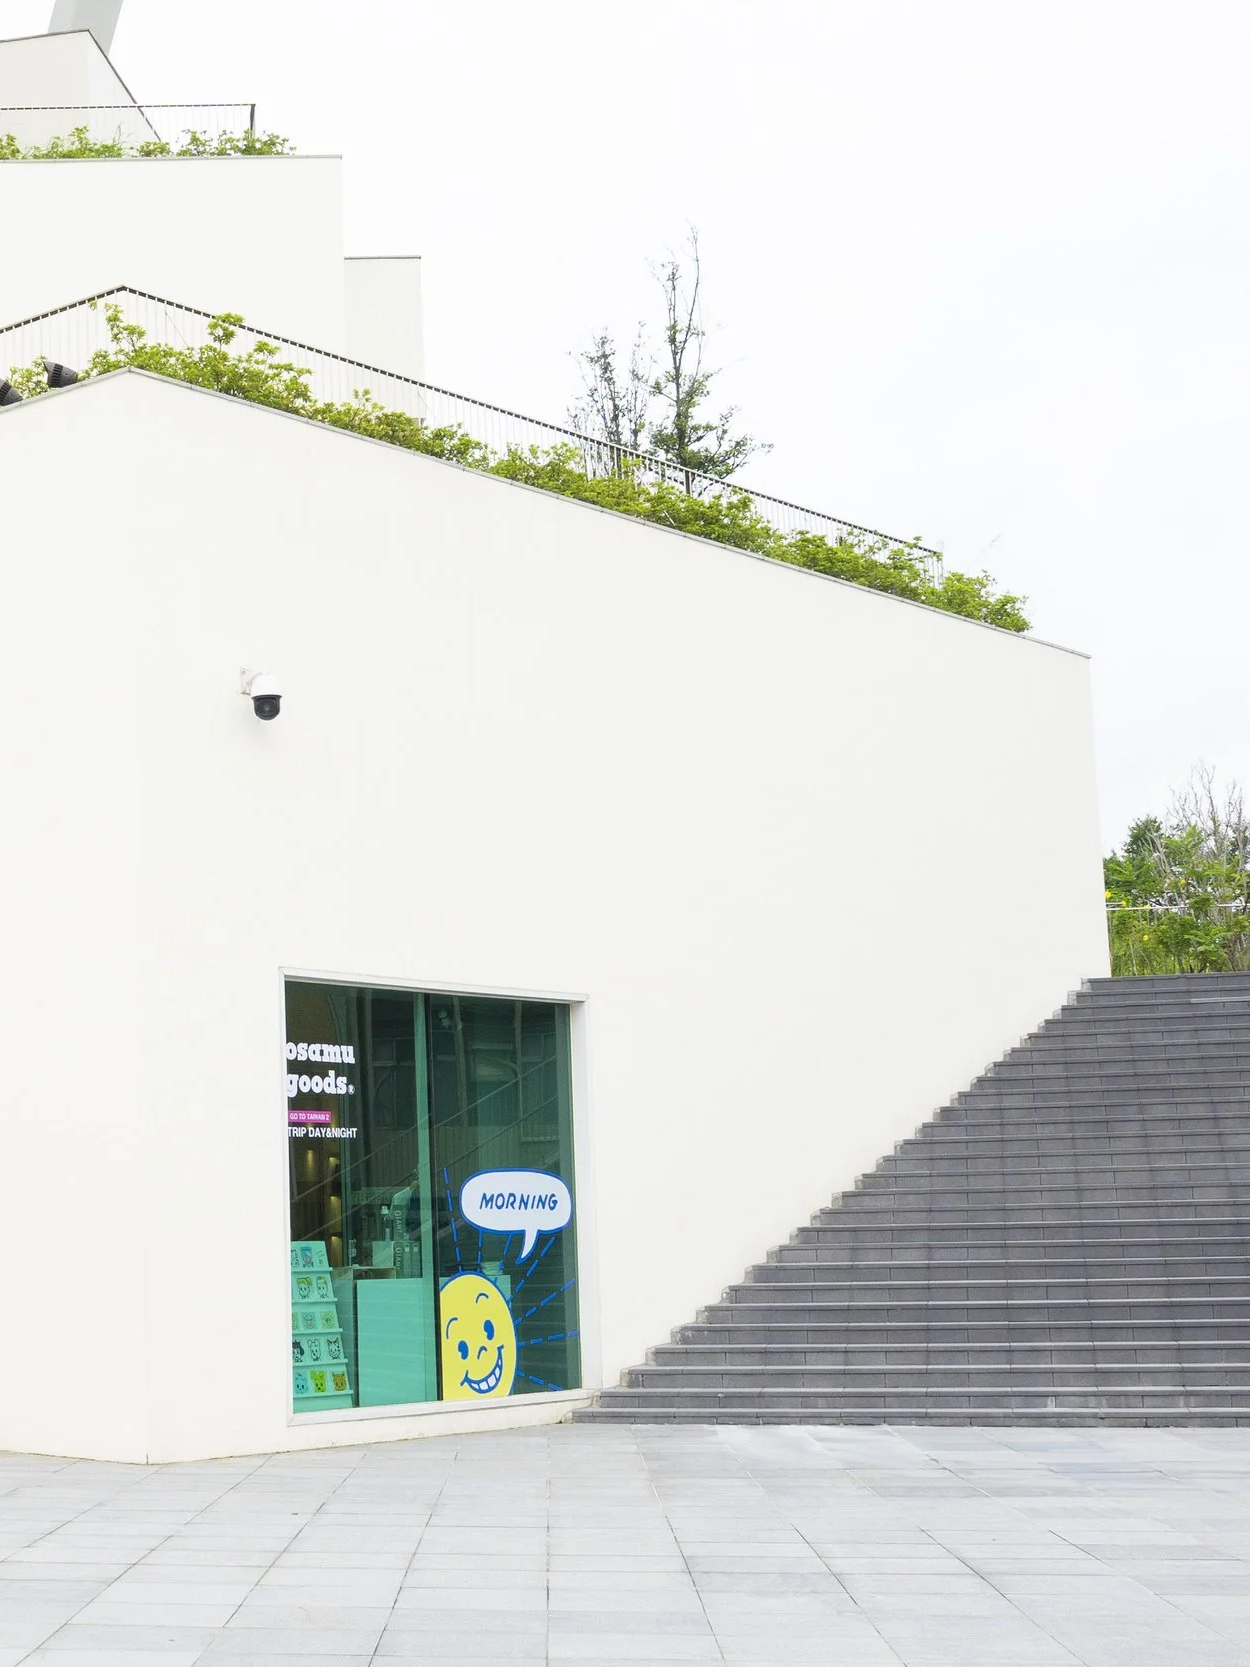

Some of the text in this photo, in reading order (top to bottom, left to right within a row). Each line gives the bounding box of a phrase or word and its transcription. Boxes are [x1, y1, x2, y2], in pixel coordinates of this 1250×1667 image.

[286, 1041, 356, 1064] osamu
[290, 1112, 298, 1120] GO
[299, 1112, 306, 1120] TO
[287, 1126, 358, 1138] TRIP DAY&NIGHT
[479, 1192, 559, 1211] MORNING
